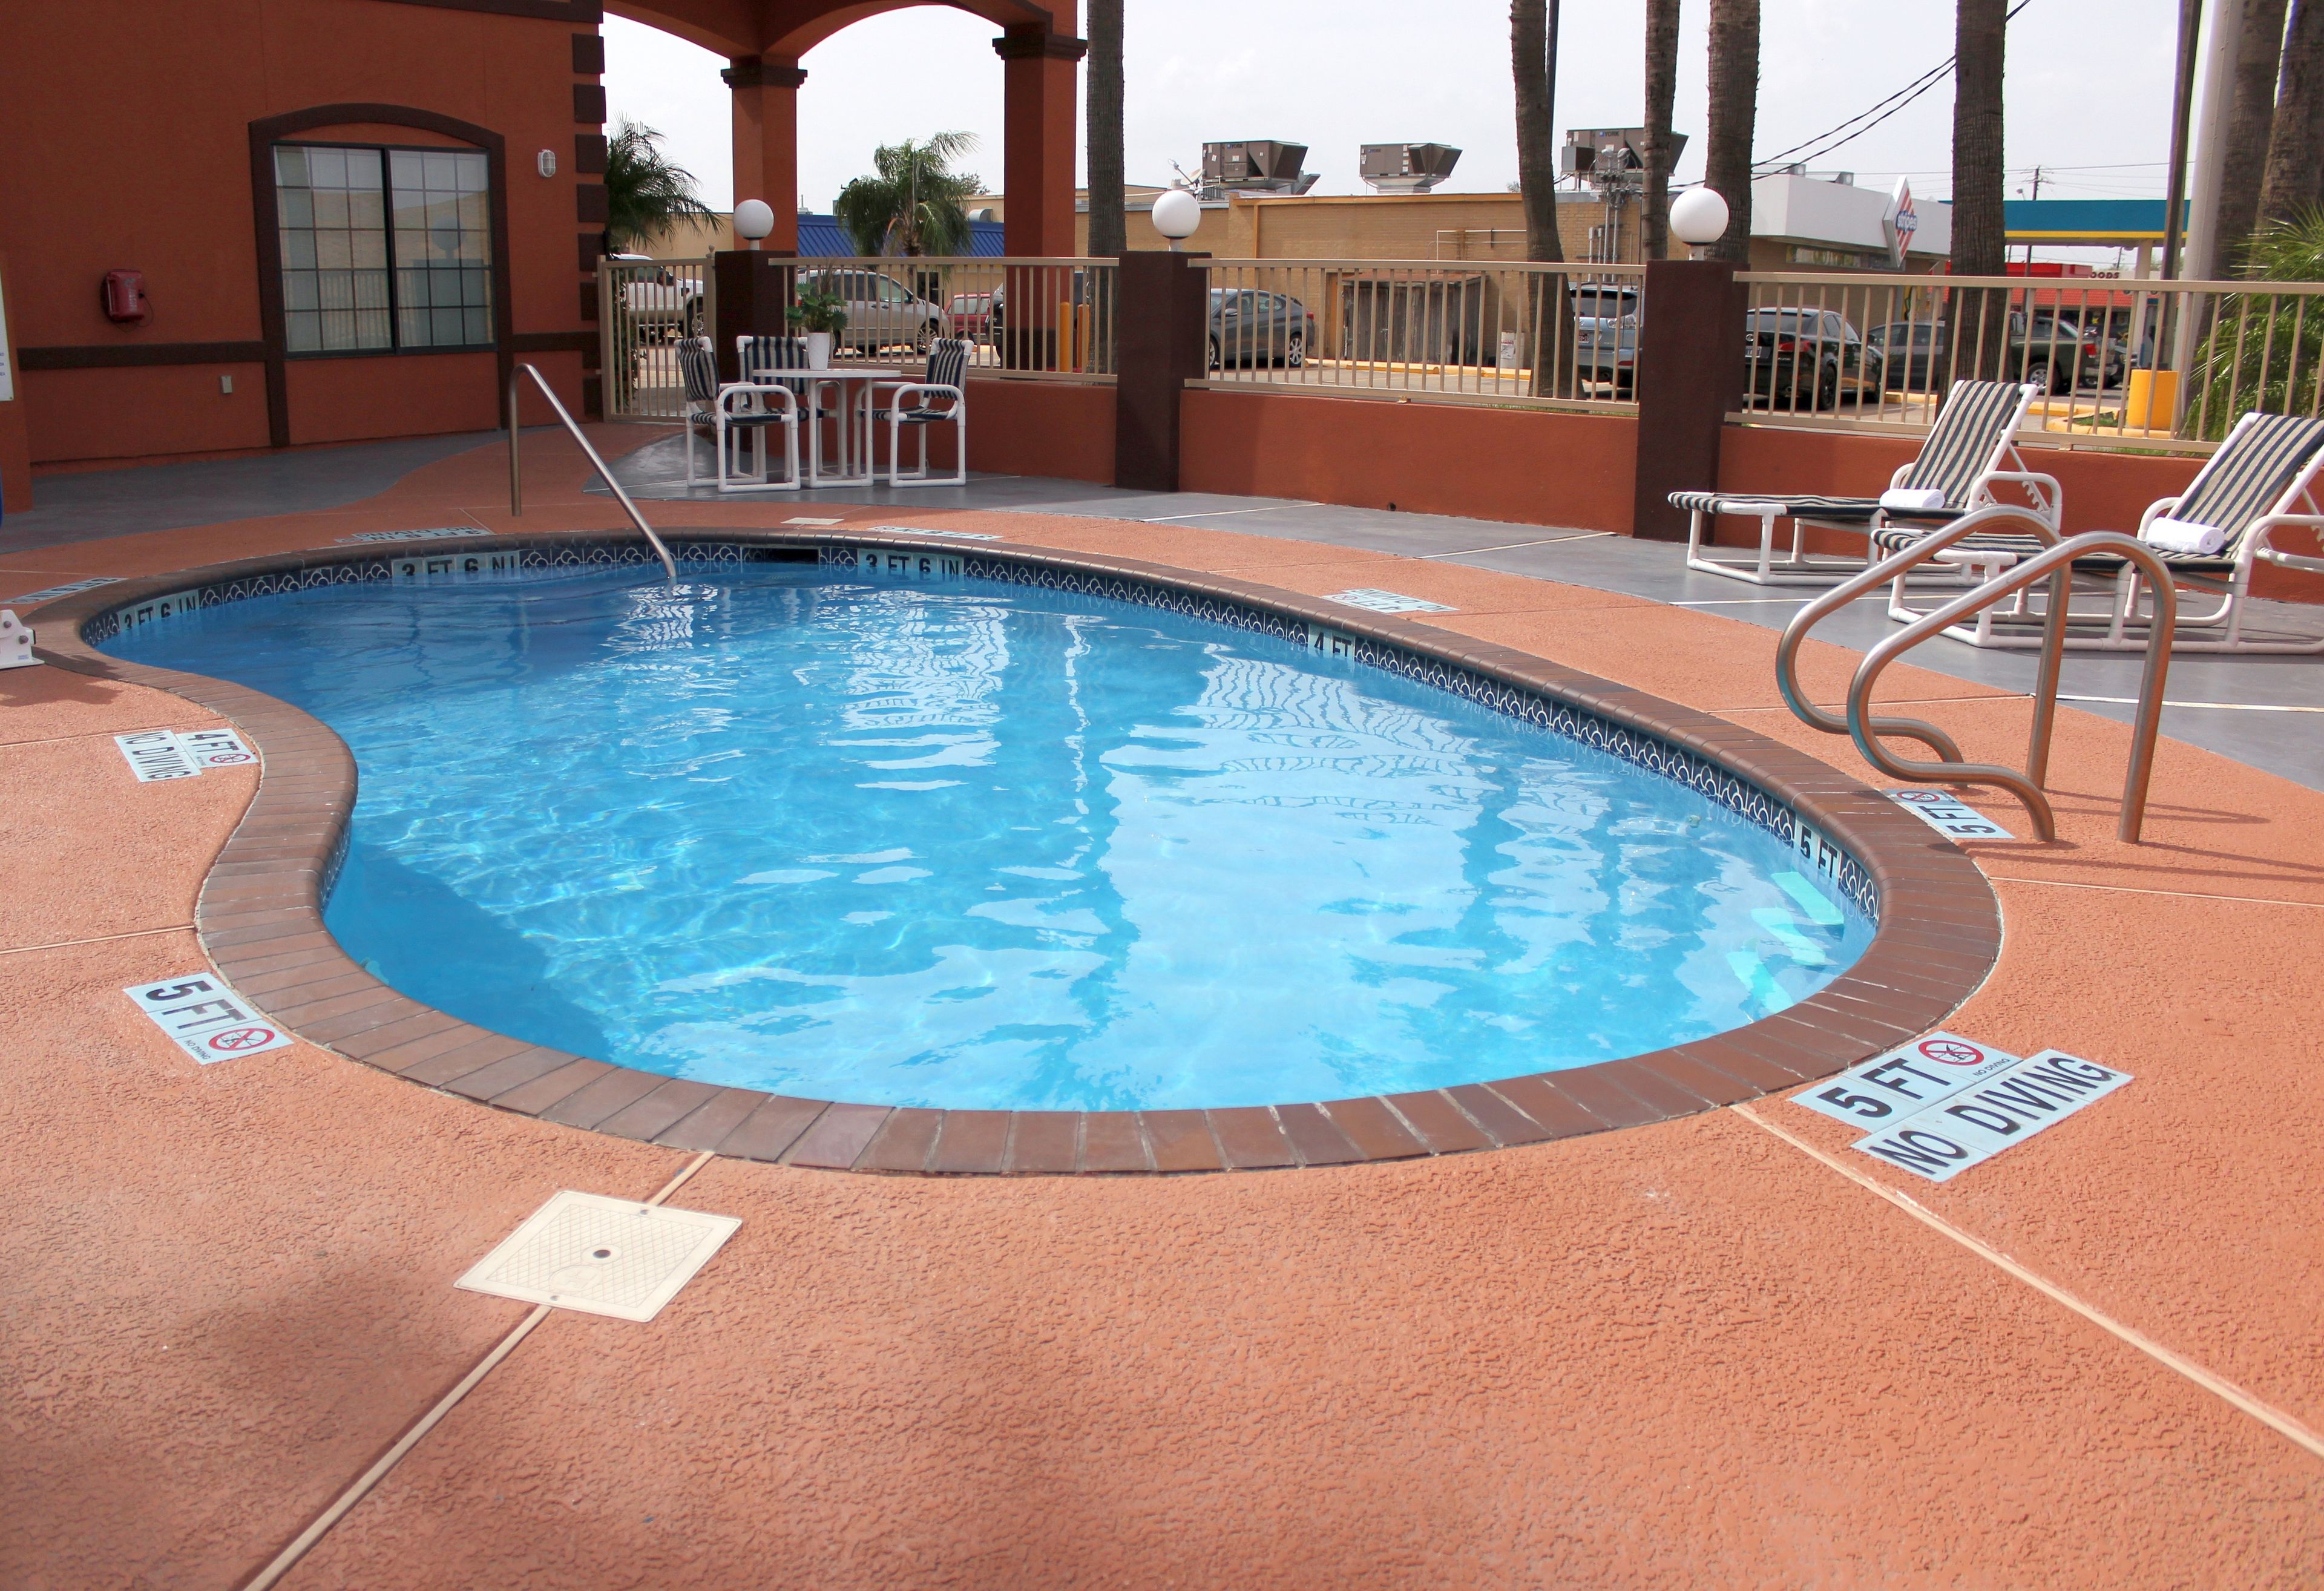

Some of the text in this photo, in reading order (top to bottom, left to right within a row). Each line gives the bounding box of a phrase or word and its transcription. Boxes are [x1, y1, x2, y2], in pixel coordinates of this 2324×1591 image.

[427, 559, 453, 575] FT
[464, 558, 479, 572] 6
[866, 553, 959, 575] 3 FT 6 IN
[138, 606, 153, 625] FT
[179, 595, 195, 614] IN
[1333, 635, 1351, 657] FT
[122, 732, 192, 779] NO DIVING
[191, 741, 240, 753] FT
[1917, 805, 1996, 835] 5 FT
[1800, 825, 1838, 879] 5 FT
[146, 980, 248, 1029] 5 FT
[184, 1039, 211, 1060] NO DIVING
[1973, 1057, 2011, 1077] NO DIVING
[1817, 1057, 1952, 1118] 5 FT
[1868, 1057, 2117, 1175] NO DIVING
